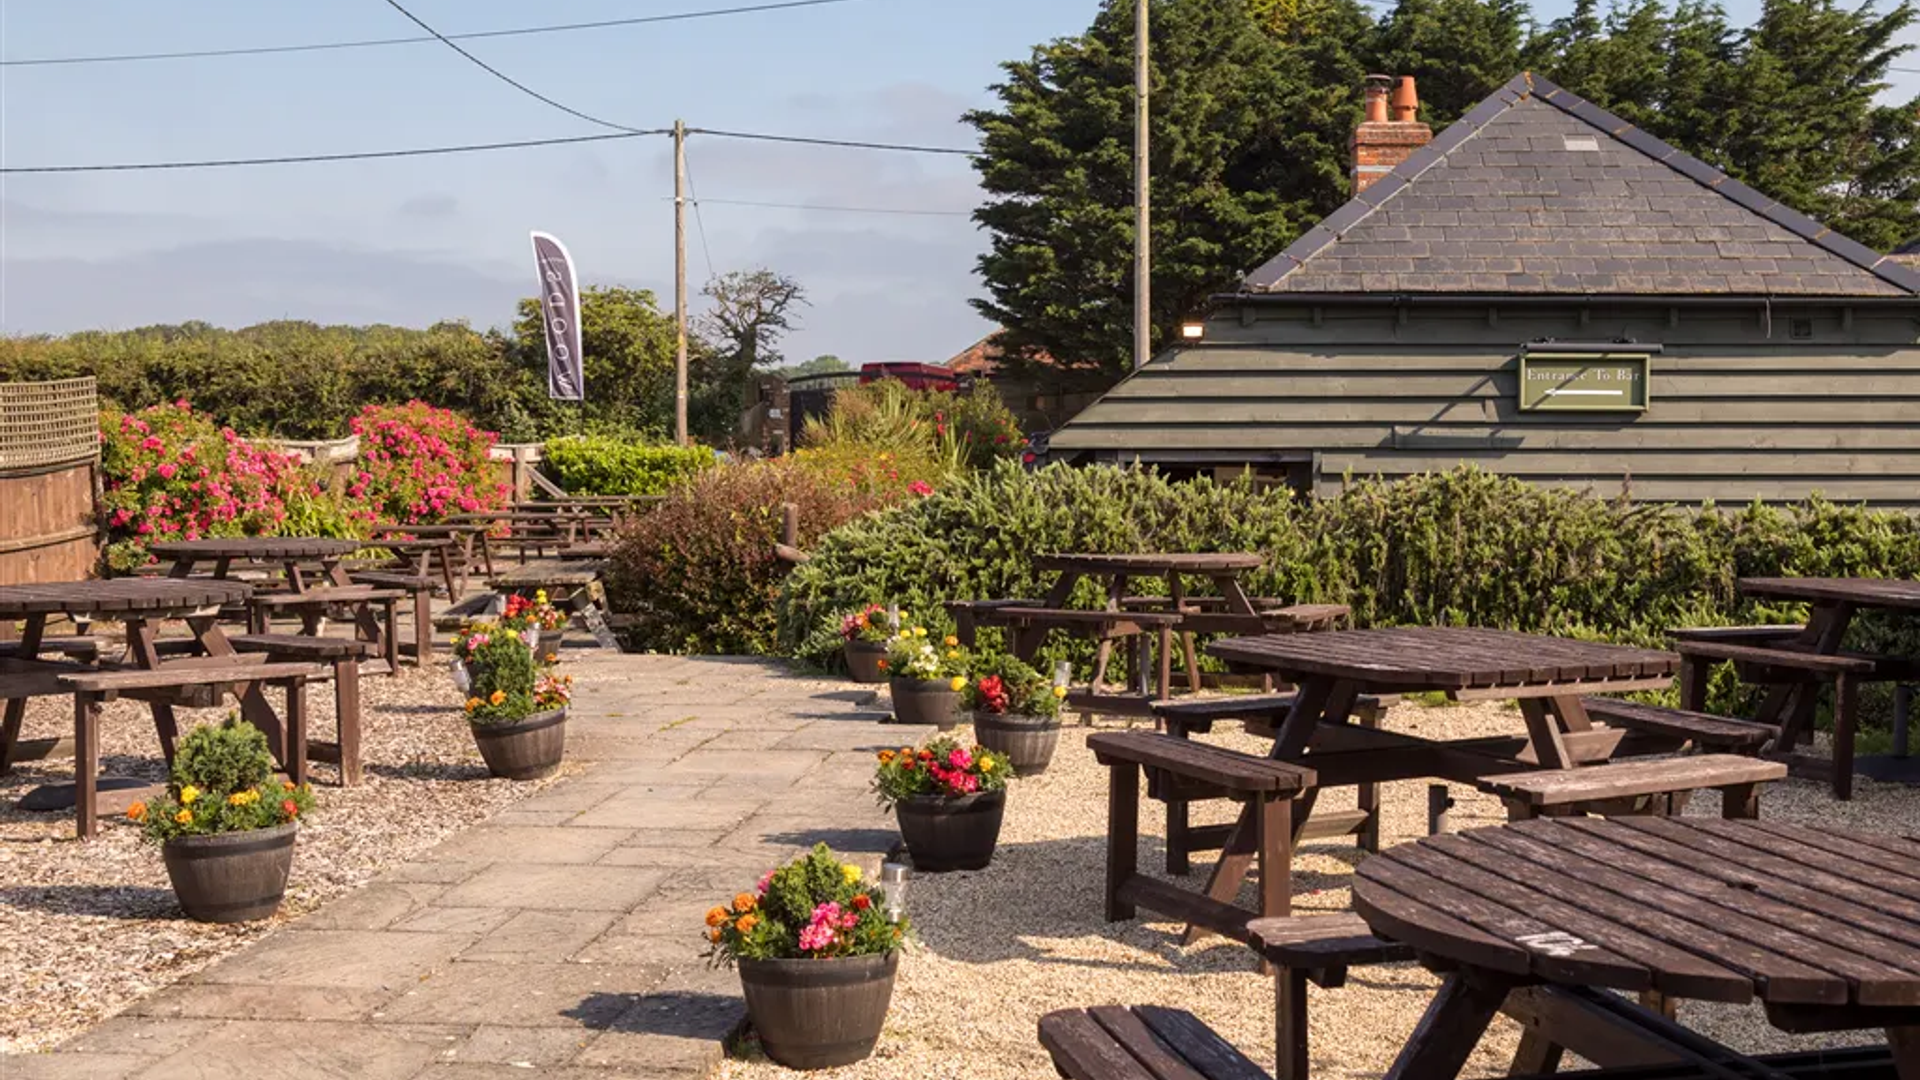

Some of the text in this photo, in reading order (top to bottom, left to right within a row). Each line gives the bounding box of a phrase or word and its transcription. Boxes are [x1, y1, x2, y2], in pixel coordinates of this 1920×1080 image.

[1527, 368, 1640, 381] Entrance To Bar
